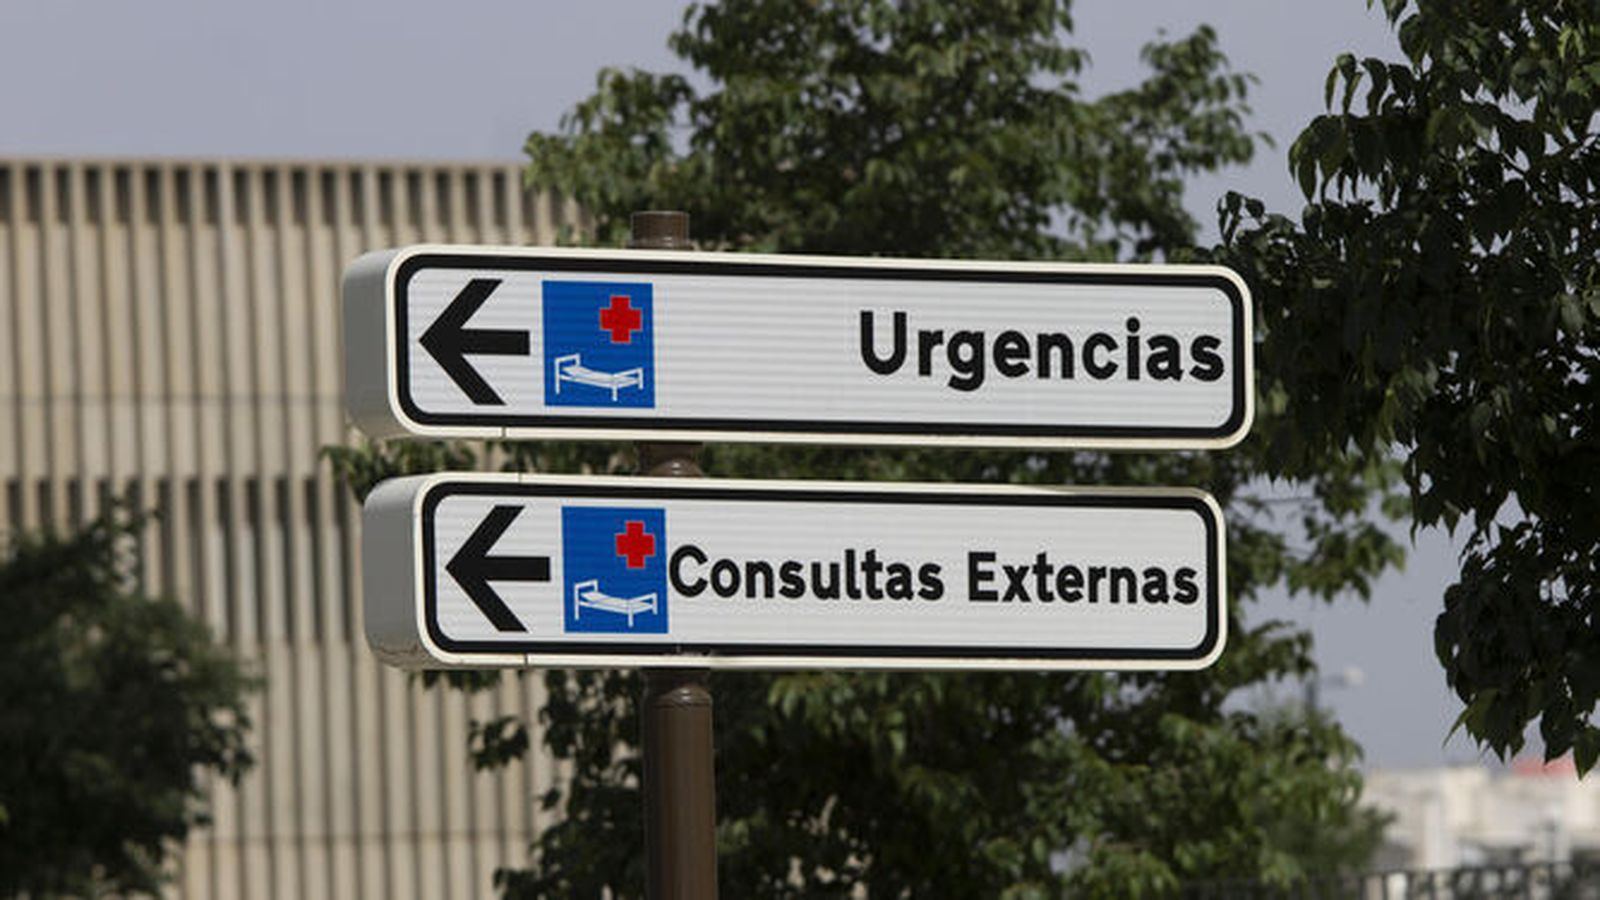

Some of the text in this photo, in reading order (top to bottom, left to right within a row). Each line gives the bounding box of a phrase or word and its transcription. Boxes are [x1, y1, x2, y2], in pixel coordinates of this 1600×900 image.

[860, 310, 1225, 392] Urgencias
[669, 544, 1199, 605] Consultas Externas
